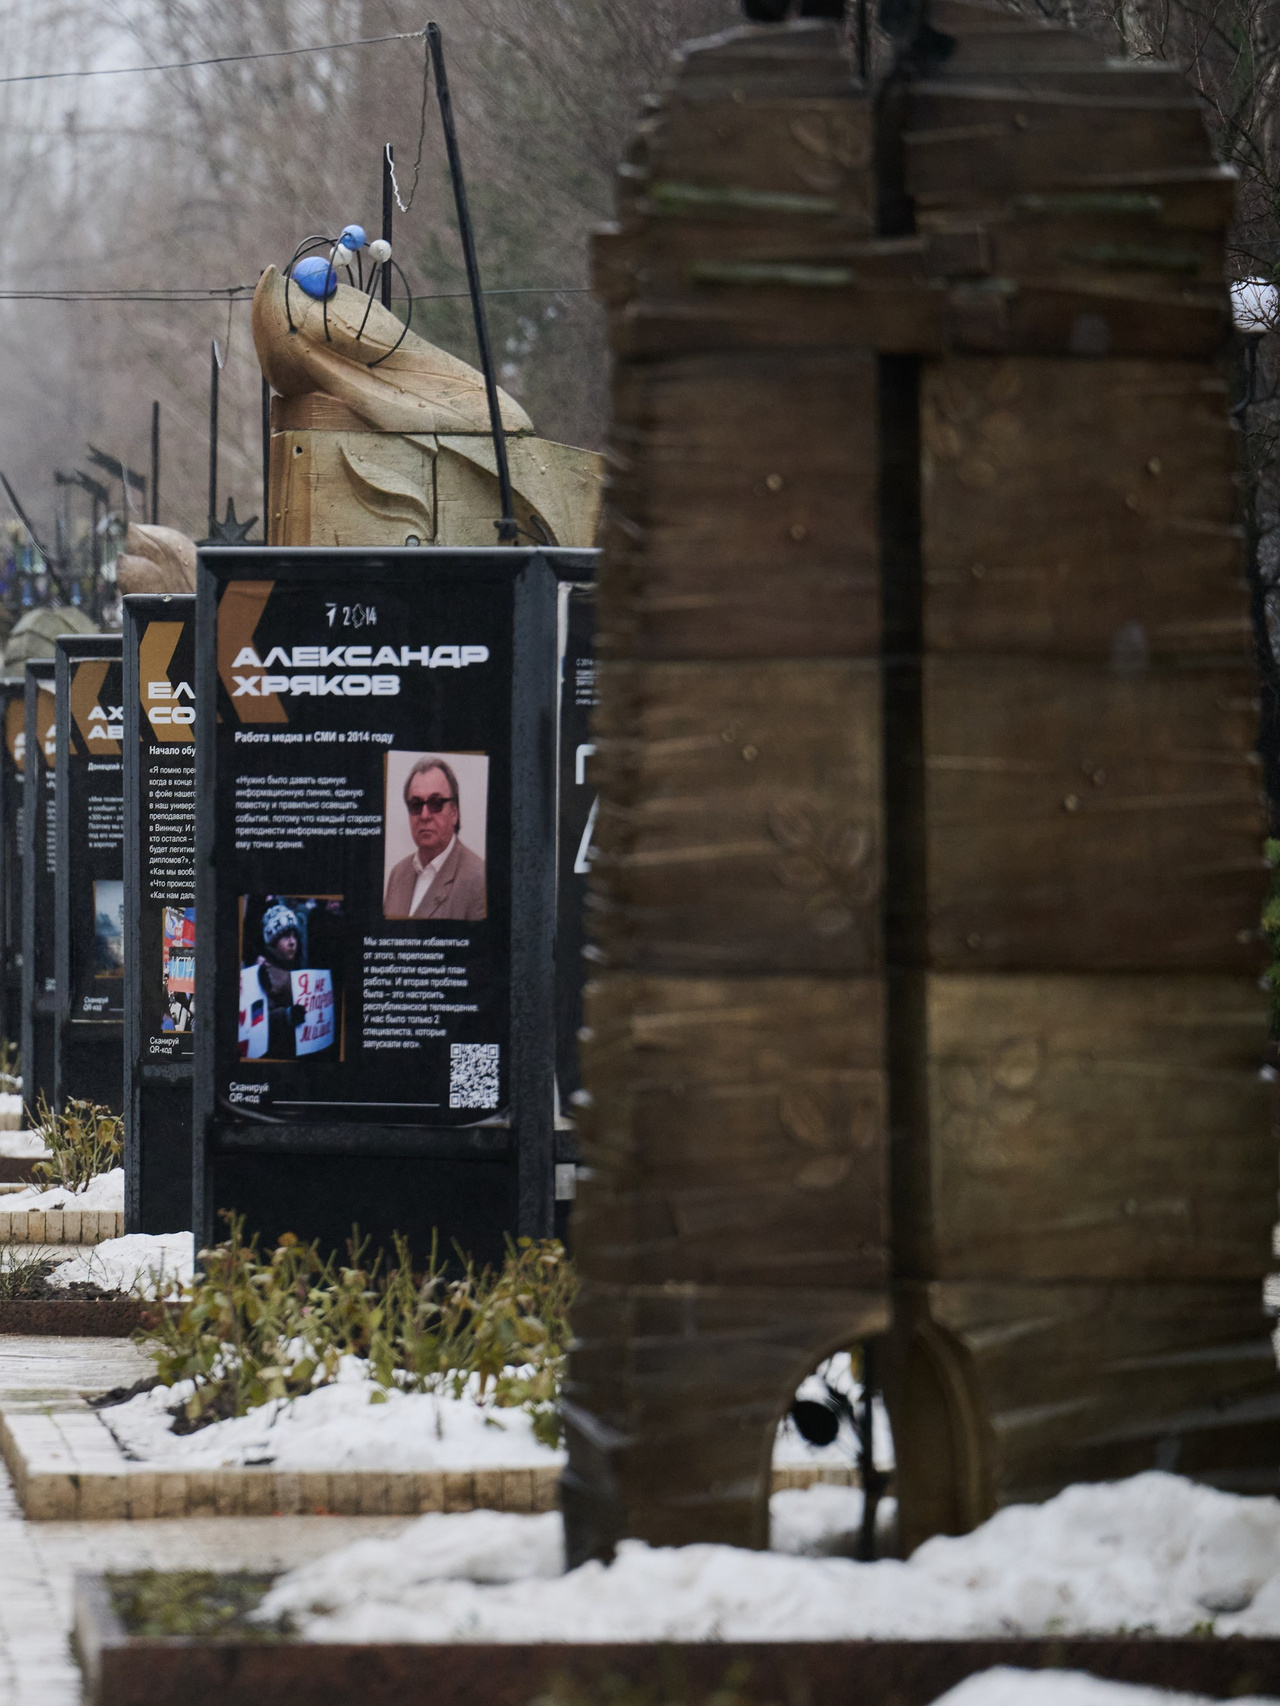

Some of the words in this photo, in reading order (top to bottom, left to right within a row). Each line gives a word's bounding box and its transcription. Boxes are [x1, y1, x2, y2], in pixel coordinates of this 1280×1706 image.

[231, 645, 489, 668] АЛЕКСАНДР
[231, 674, 400, 696] ХРЯКОВ
[235, 731, 270, 742] Работа
[272, 733, 303, 743] медиа
[305, 733, 312, 742] и
[313, 731, 337, 742] СМИ
[338, 733, 345, 742] в
[347, 731, 370, 742] 2014
[371, 733, 394, 744] году
[149, 745, 179, 755] Начало
[149, 766, 158, 774] «Я
[160, 766, 181, 774] помню
[149, 779, 167, 787] когда
[174, 779, 192, 787] конце
[235, 775, 266, 786] «Нужно
[267, 774, 288, 785] было
[289, 776, 316, 786] давать
[317, 776, 347, 786] единую
[149, 790, 153, 798] в
[155, 789, 173, 799] фойе
[235, 788, 305, 798] информационную
[334, 788, 364, 798] единую
[235, 801, 270, 810] повестку
[271, 801, 277, 809] и
[278, 801, 320, 810] правильно
[321, 801, 358, 810] освещать
[272, 814, 300, 824] потому
[302, 814, 314, 823] что
[316, 813, 345, 824] каждый
[346, 814, 382, 824] старался
[155, 824, 183, 833] Винницу.
[235, 827, 286, 836] преподнести
[287, 826, 337, 836] информацию
[345, 826, 382, 836] выгодной
[149, 845, 168, 854] будет
[235, 841, 250, 850] ему
[150, 879, 166, 887] «Что
[150, 891, 165, 899] «Как
[363, 936, 377, 946] Мы
[379, 938, 421, 947] заставляли
[423, 936, 470, 947] избавляться
[363, 952, 372, 960] от
[397, 952, 445, 961] переломали
[370, 964, 416, 975] выработали
[417, 965, 446, 974] единый
[447, 966, 466, 974] план
[395, 977, 402, 986] И
[403, 978, 429, 988] вторая
[431, 977, 468, 988] проблема
[363, 989, 384, 998] была
[392, 990, 404, 998] это
[406, 991, 445, 1000] настроить
[363, 1001, 428, 1013] республиканское
[363, 1014, 369, 1023] У
[370, 1015, 384, 1023] нас
[385, 1014, 406, 1023] было
[407, 1015, 433, 1024] только
[434, 1014, 440, 1024] 2
[415, 1028, 447, 1038] которые
[150, 1036, 179, 1046] Сканируй
[363, 1040, 402, 1050] запускали
[150, 1045, 172, 1054] QR-код
[229, 1082, 269, 1094] Сканируй
[229, 1093, 260, 1104] QR-код
